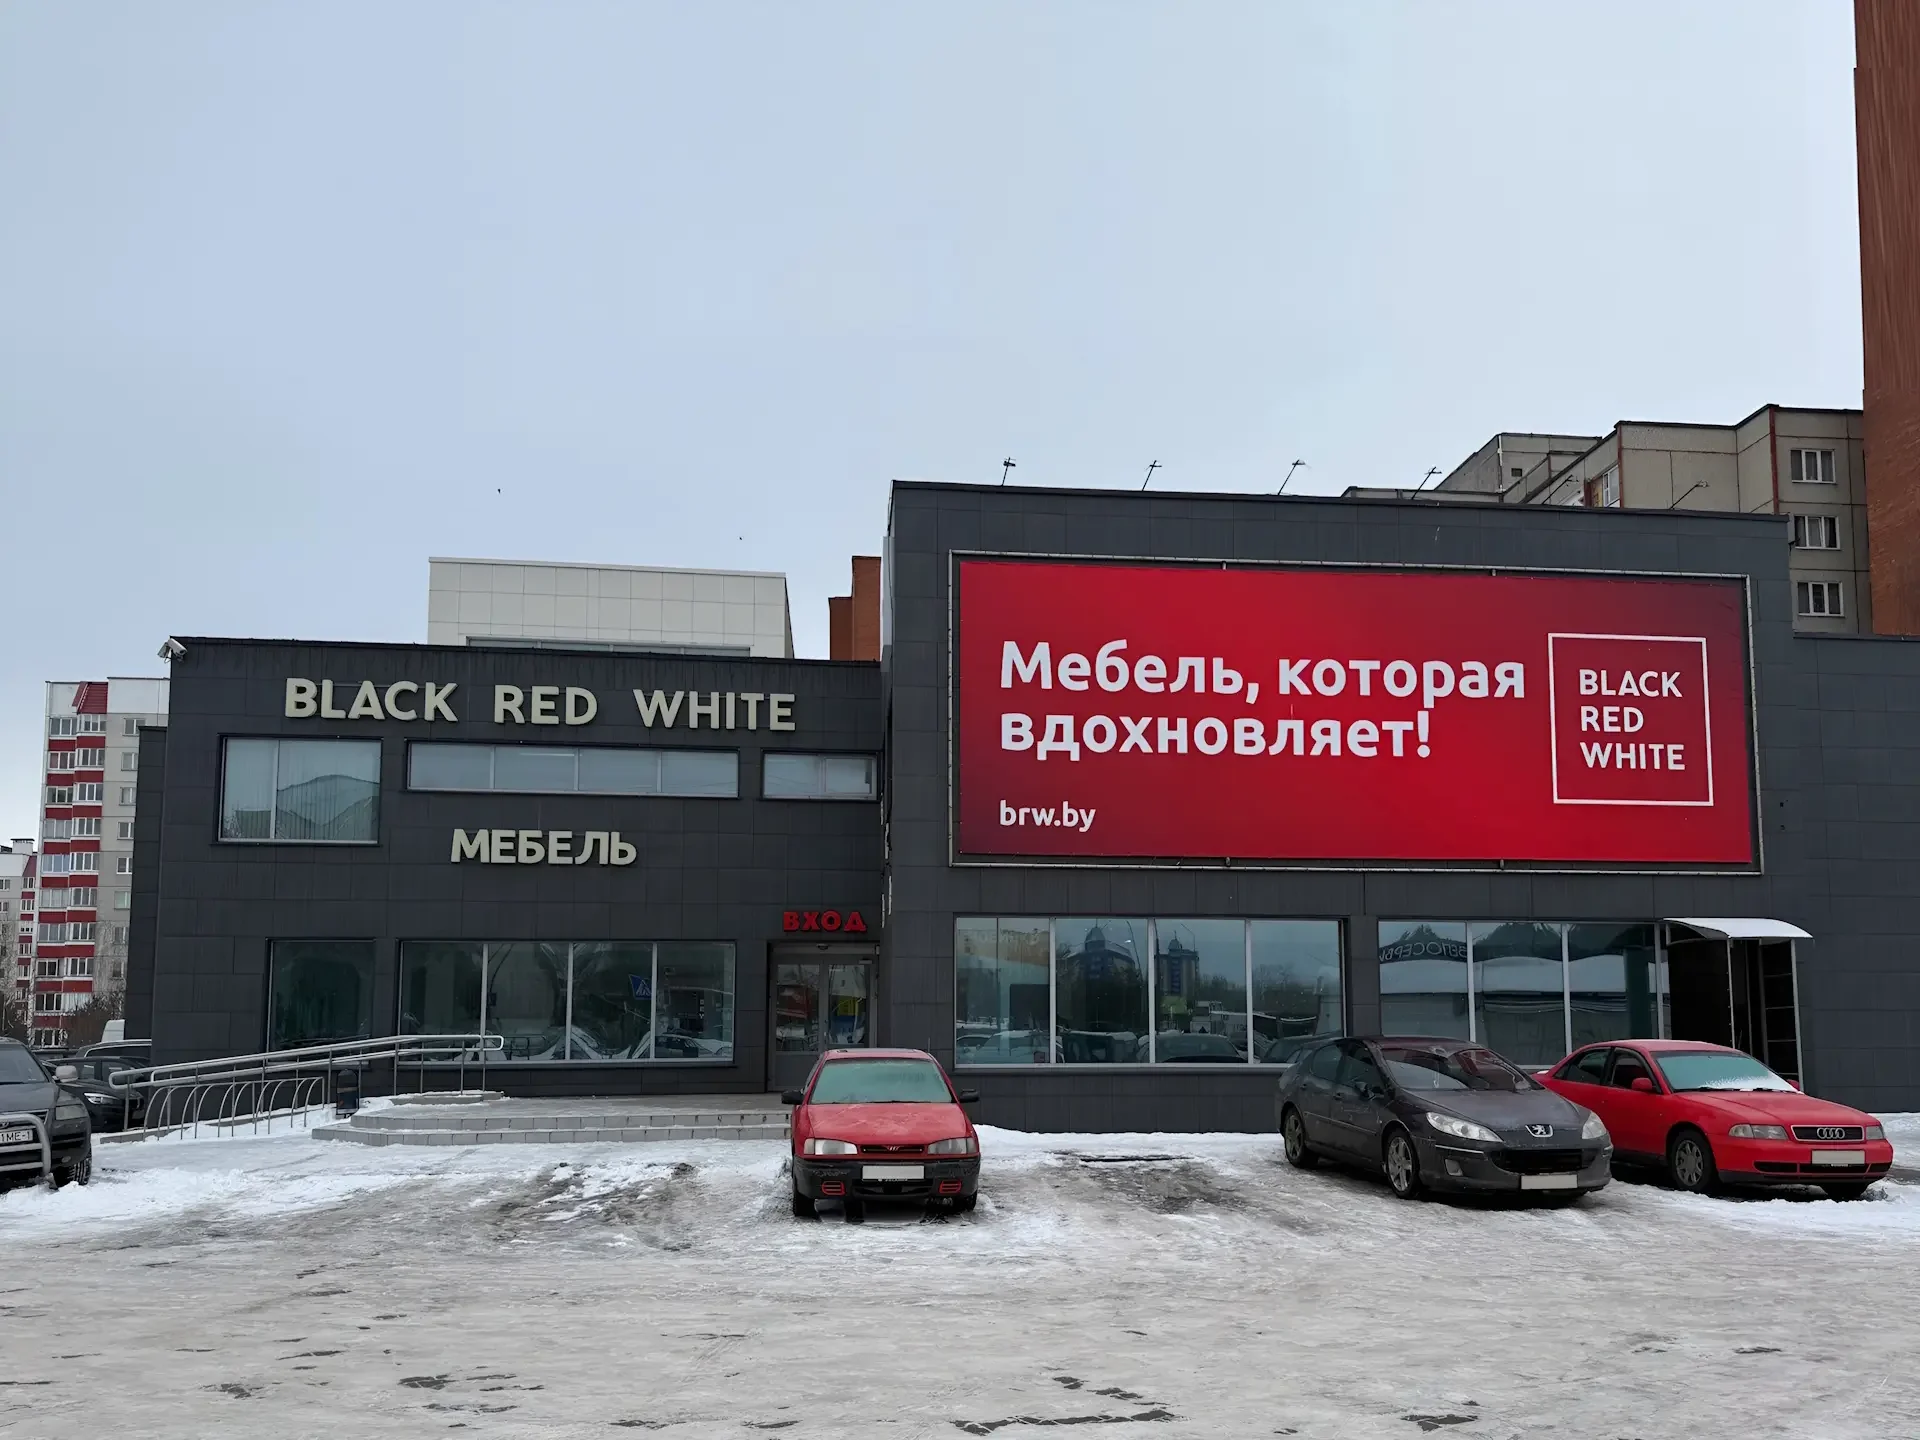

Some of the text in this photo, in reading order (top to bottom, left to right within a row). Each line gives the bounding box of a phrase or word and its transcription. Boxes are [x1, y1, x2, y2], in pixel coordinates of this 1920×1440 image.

[999, 639, 1526, 712] Мебель, которая
[1579, 669, 1683, 698] BLACK
[285, 677, 797, 732] BLACK RED WHITE
[1580, 705, 1645, 733] RED
[1000, 710, 1432, 762] вдохновляет!
[1579, 741, 1687, 772] WHITE
[998, 799, 1097, 834] brw.by
[450, 828, 638, 865] МЕБЕЛЬ
[783, 910, 867, 933] ВХОД
